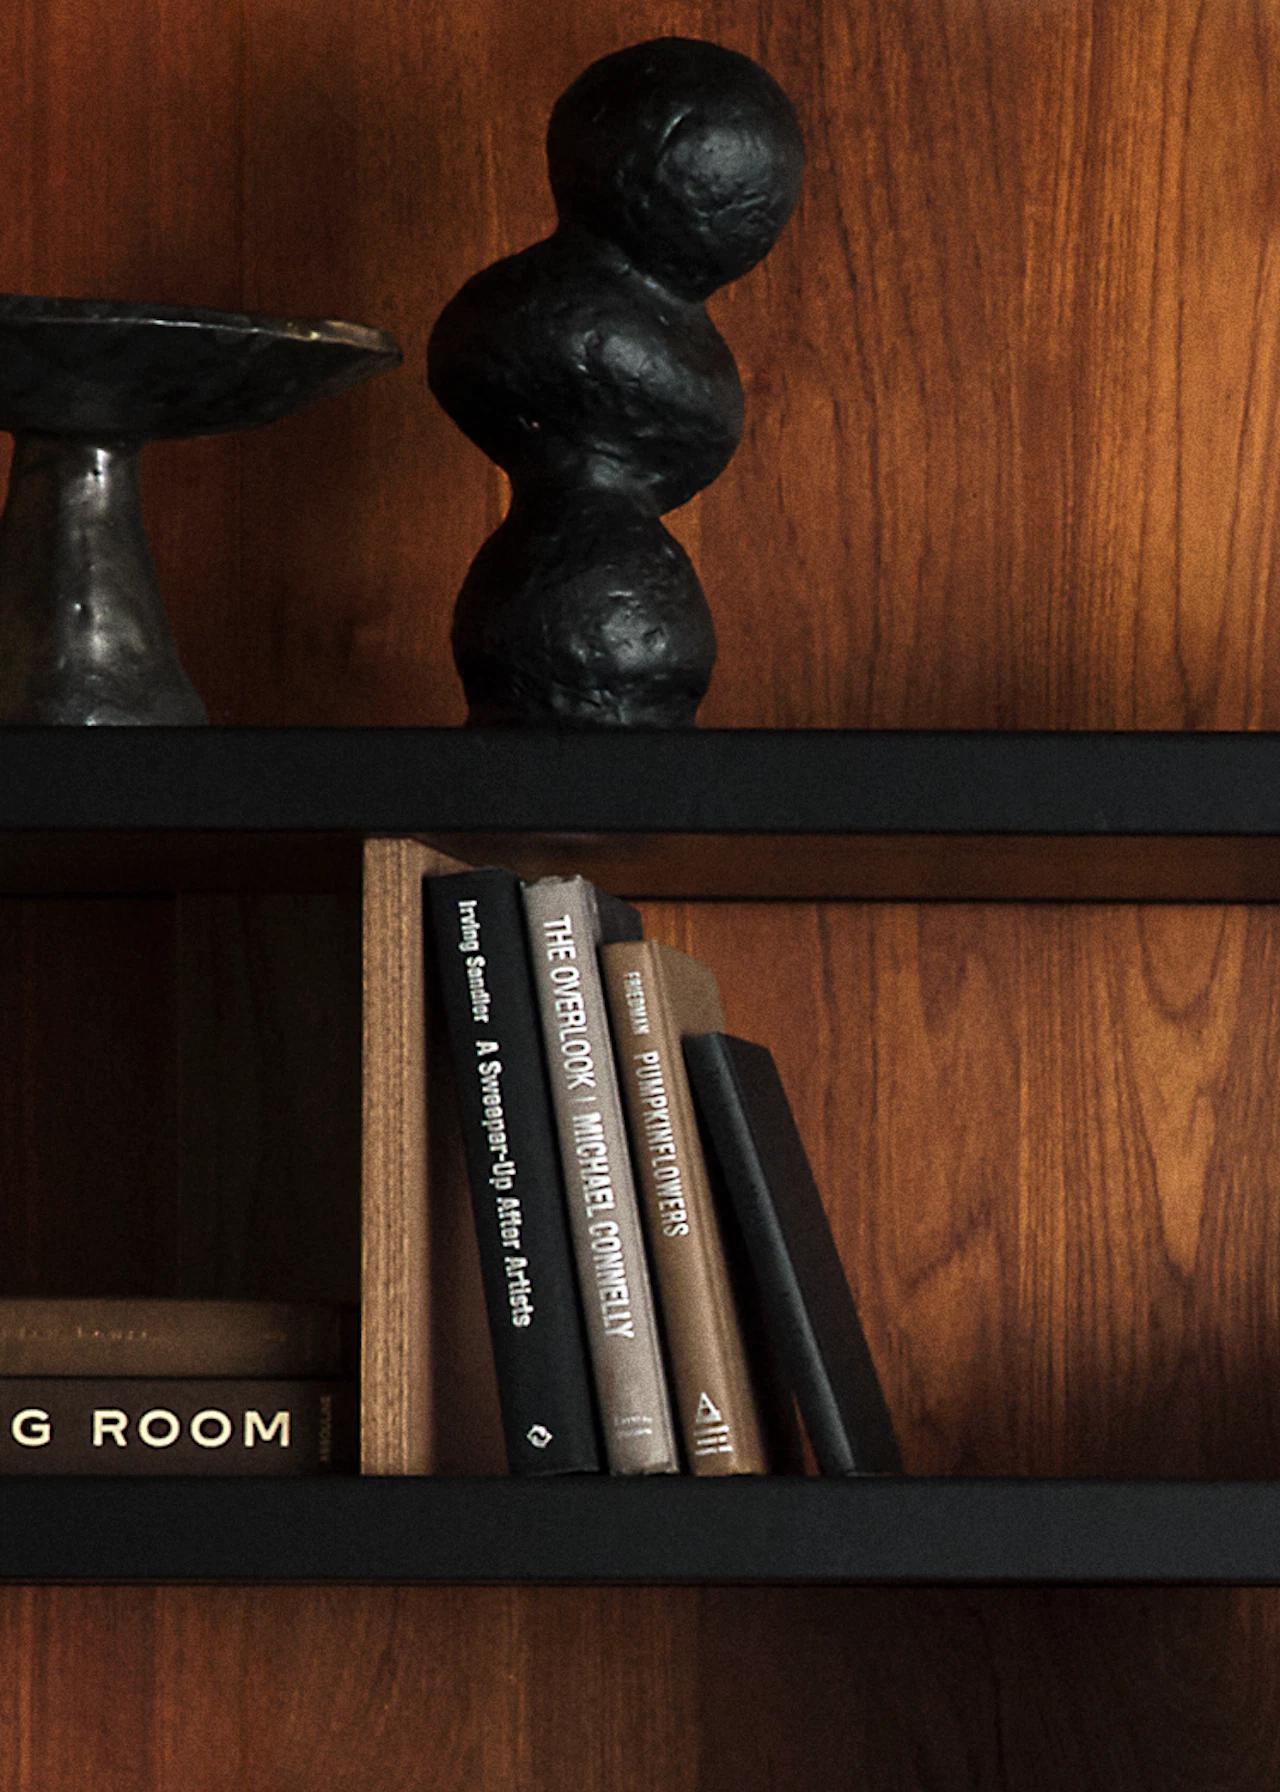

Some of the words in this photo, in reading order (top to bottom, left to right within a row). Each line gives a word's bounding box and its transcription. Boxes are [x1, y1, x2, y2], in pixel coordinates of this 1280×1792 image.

[458, 900, 481, 952] Irving
[543, 914, 577, 961] THE
[465, 955, 491, 1023] Sandler
[475, 1040, 499, 1056] A
[550, 966, 597, 1090] OVERLOOK
[478, 1060, 517, 1190] Sweeper-Up
[634, 1050, 690, 1237] PUMPKINFLOWERS
[572, 1111, 616, 1218] MICHAEL
[496, 1197, 523, 1249] After
[504, 1256, 535, 1328] Artists
[588, 1220, 635, 1339] CONNELLY
[11, 1408, 51, 1447] G
[92, 1408, 291, 1448] ROOM
